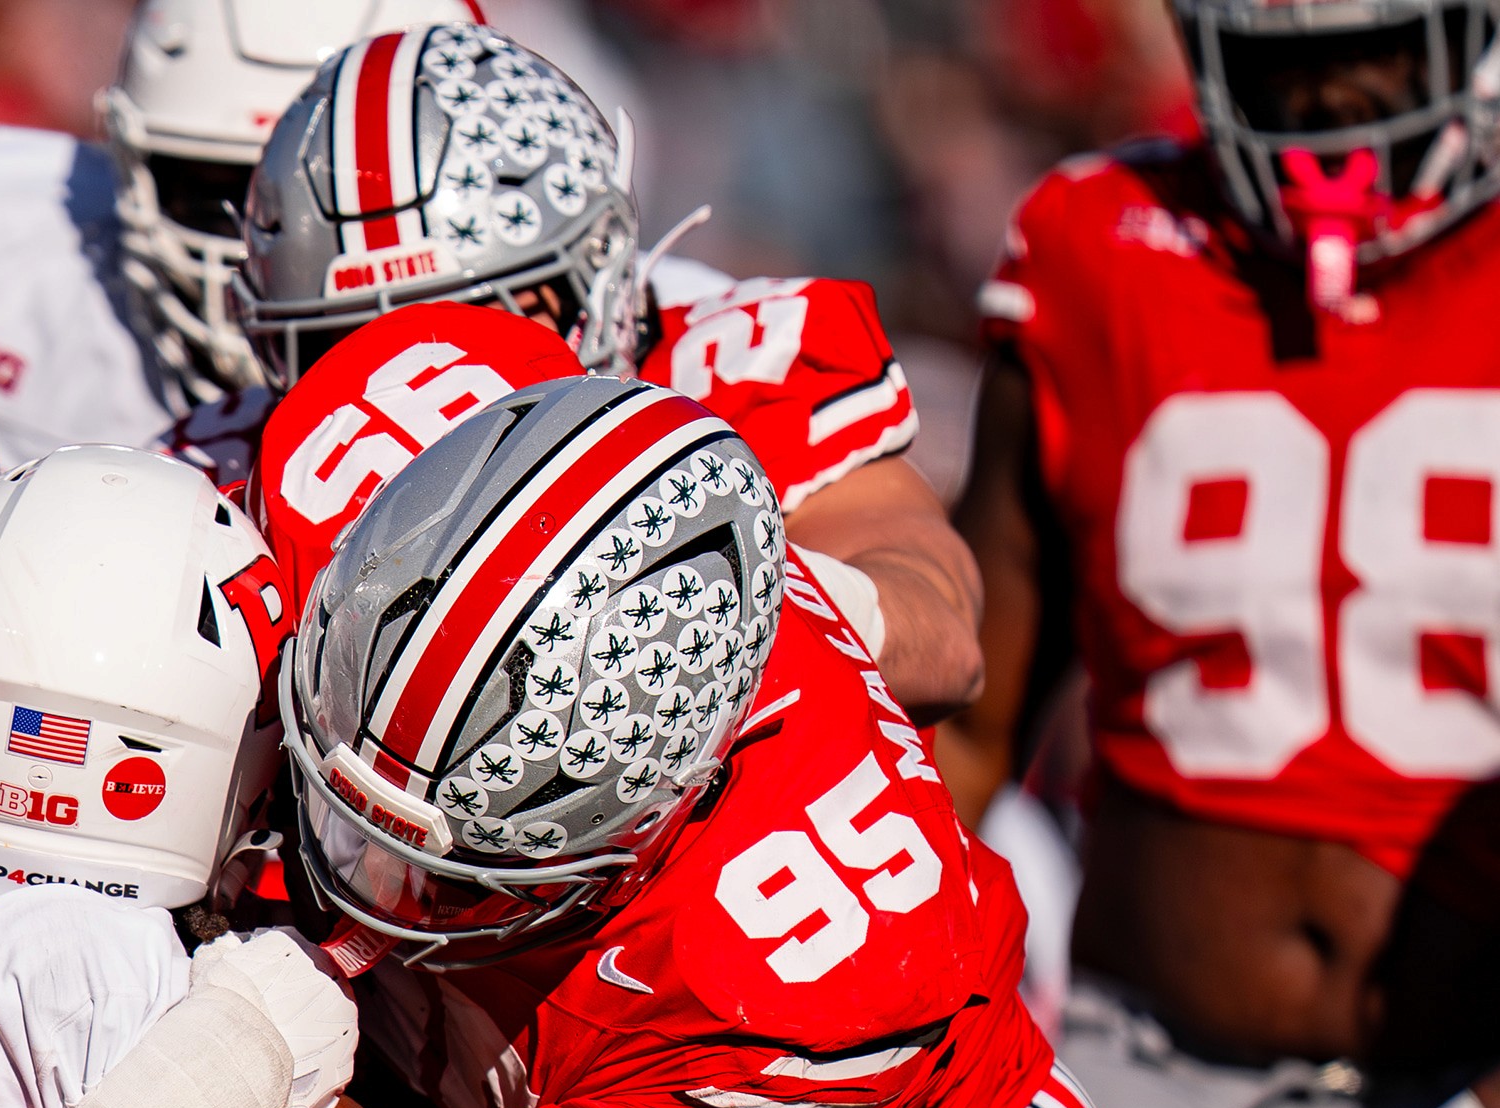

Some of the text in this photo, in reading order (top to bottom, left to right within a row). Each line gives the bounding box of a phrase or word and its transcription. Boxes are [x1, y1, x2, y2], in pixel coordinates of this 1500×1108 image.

[382, 250, 436, 282] STATE
[280, 342, 516, 525] 56
[1116, 387, 1500, 783] 98
[105, 780, 166, 796] BELIEVE
[329, 767, 429, 848] OHIO STATE
[714, 749, 943, 984] 95
